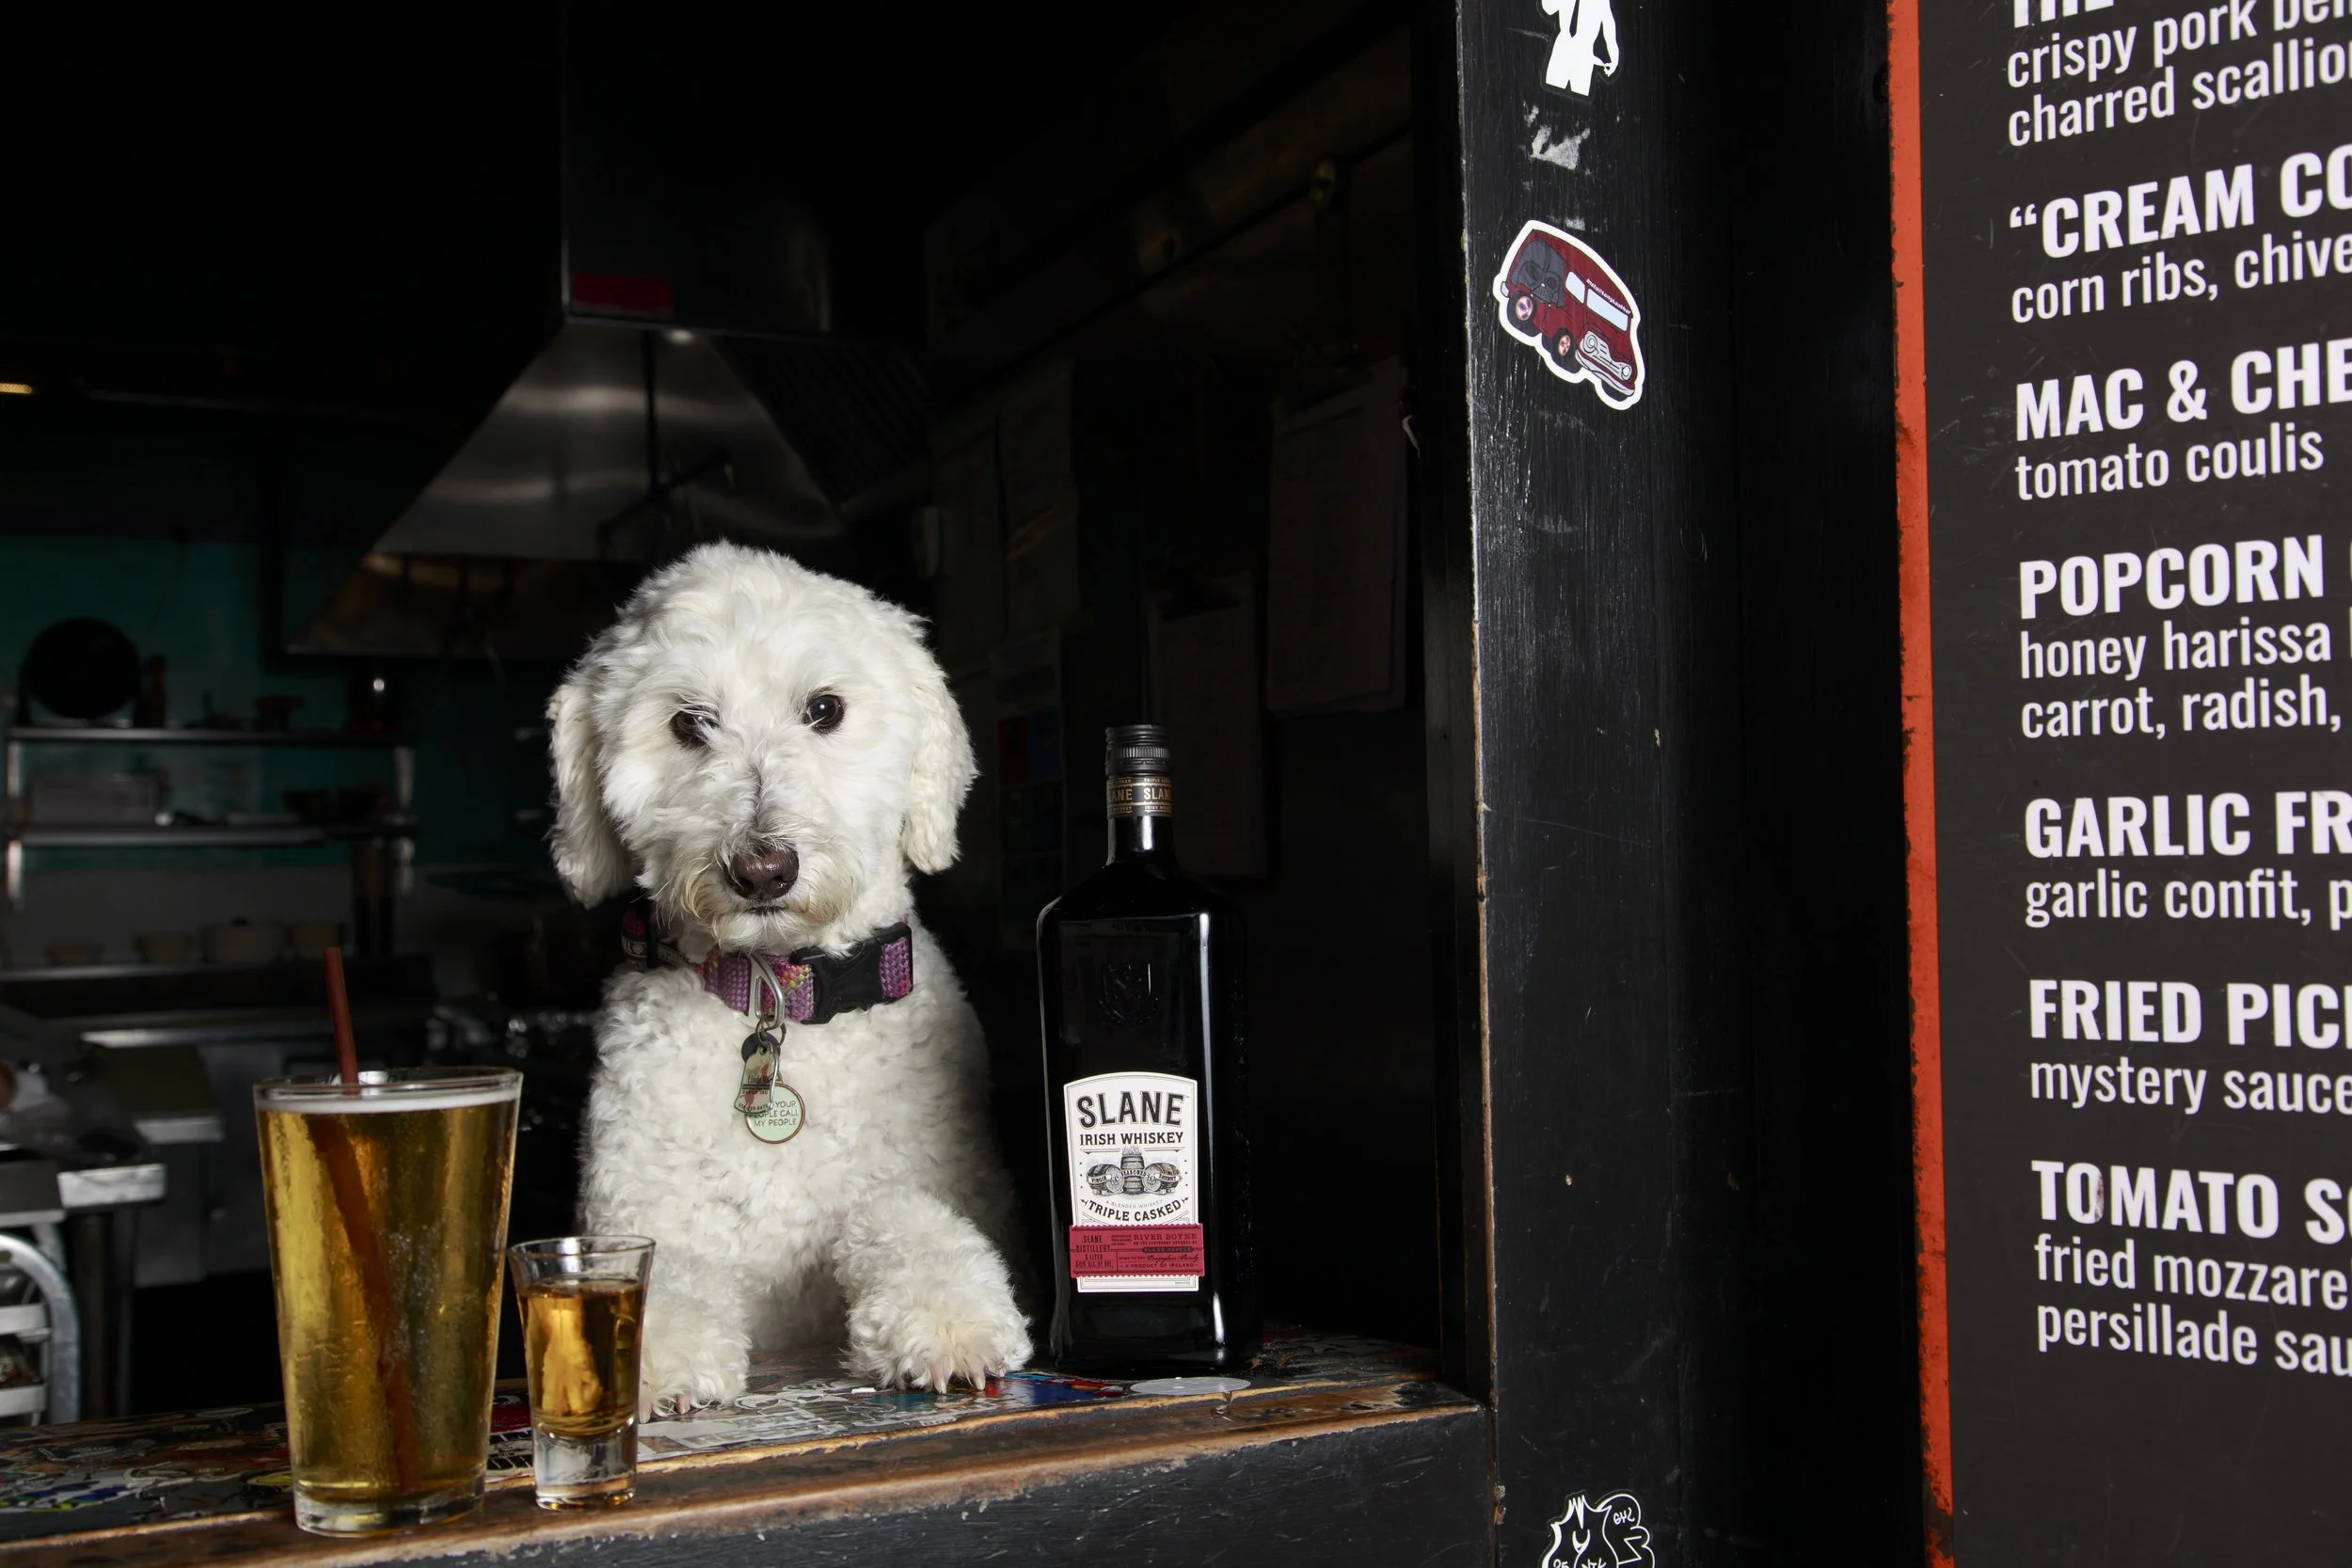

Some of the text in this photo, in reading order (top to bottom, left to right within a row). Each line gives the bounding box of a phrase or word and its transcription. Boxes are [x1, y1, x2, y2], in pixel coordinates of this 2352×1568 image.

[2008, 26, 2137, 88] crispy
[2153, 0, 2258, 68] pork
[2009, 37, 2352, 147] charred scallio
[2011, 230, 2352, 324] corn ribs, chive
[2016, 339, 2352, 441] MAC & CHE
[2015, 422, 2324, 500] tomato coulis
[2020, 534, 2324, 619] POPCORN
[2021, 631, 2146, 681] honey
[2164, 616, 2331, 671] harissa
[2021, 673, 2342, 739] carrot, radish,
[2025, 790, 2352, 858] GARLIC FR
[2025, 868, 2148, 928] garlic
[2165, 868, 2312, 926] confit,
[2029, 979, 2352, 1050] FRIED PIC
[775, 1100, 797, 1108] YOUR
[780, 1109, 799, 1117] CALL
[1076, 1090, 1184, 1130] SLANE
[2030, 1056, 2352, 1116] mystery sauce
[768, 1117, 797, 1127] PEOPLE
[1080, 1132, 1184, 1146] IRISH WHISKEY
[1089, 1200, 1182, 1221] TRIPLE CASKED
[1138, 1199, 1163, 1208] WHISKEY
[2031, 1160, 2352, 1245] TOMATO S
[2034, 1233, 2352, 1310] fried mozzare
[2037, 1303, 2352, 1377] persillade sau
